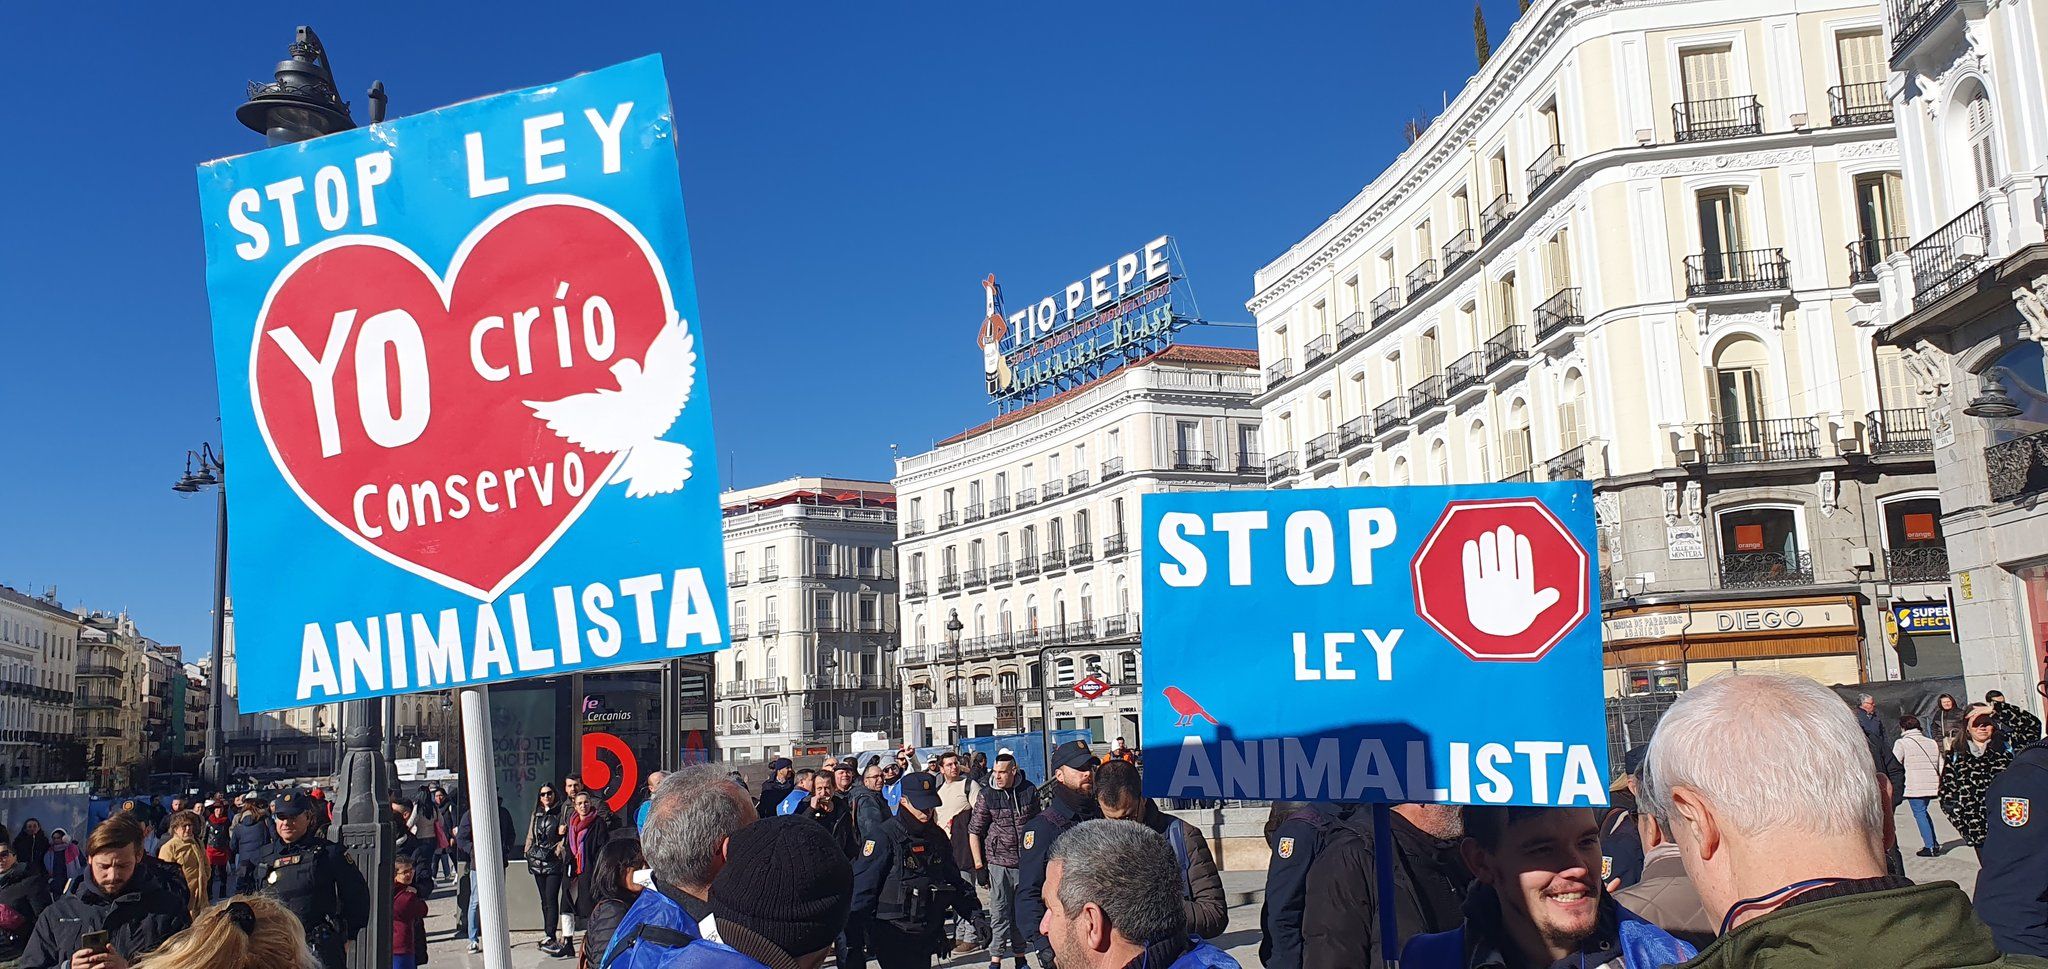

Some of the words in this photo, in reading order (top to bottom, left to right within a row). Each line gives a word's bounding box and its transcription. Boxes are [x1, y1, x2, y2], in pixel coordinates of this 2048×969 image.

[229, 150, 393, 260] STOP
[465, 102, 634, 198] LEY
[1009, 296, 1056, 346] TIO
[1065, 235, 1169, 320] PEPE
[1113, 303, 1173, 349] BYASS
[267, 308, 430, 459] YO
[470, 282, 615, 382] crío
[1158, 507, 1397, 587] STOP
[1671, 551, 1703, 559] MONTERA
[1738, 541, 1761, 549] orange
[296, 567, 721, 700] ANIMALISTA
[1716, 608, 1804, 631] DIEGO
[1912, 607, 1950, 617] SUPER
[1292, 628, 1404, 681] LEY
[587, 710, 631, 722] Cercanías
[534, 735, 551, 751] TE
[1167, 735, 1608, 806] ANIMALISTA
